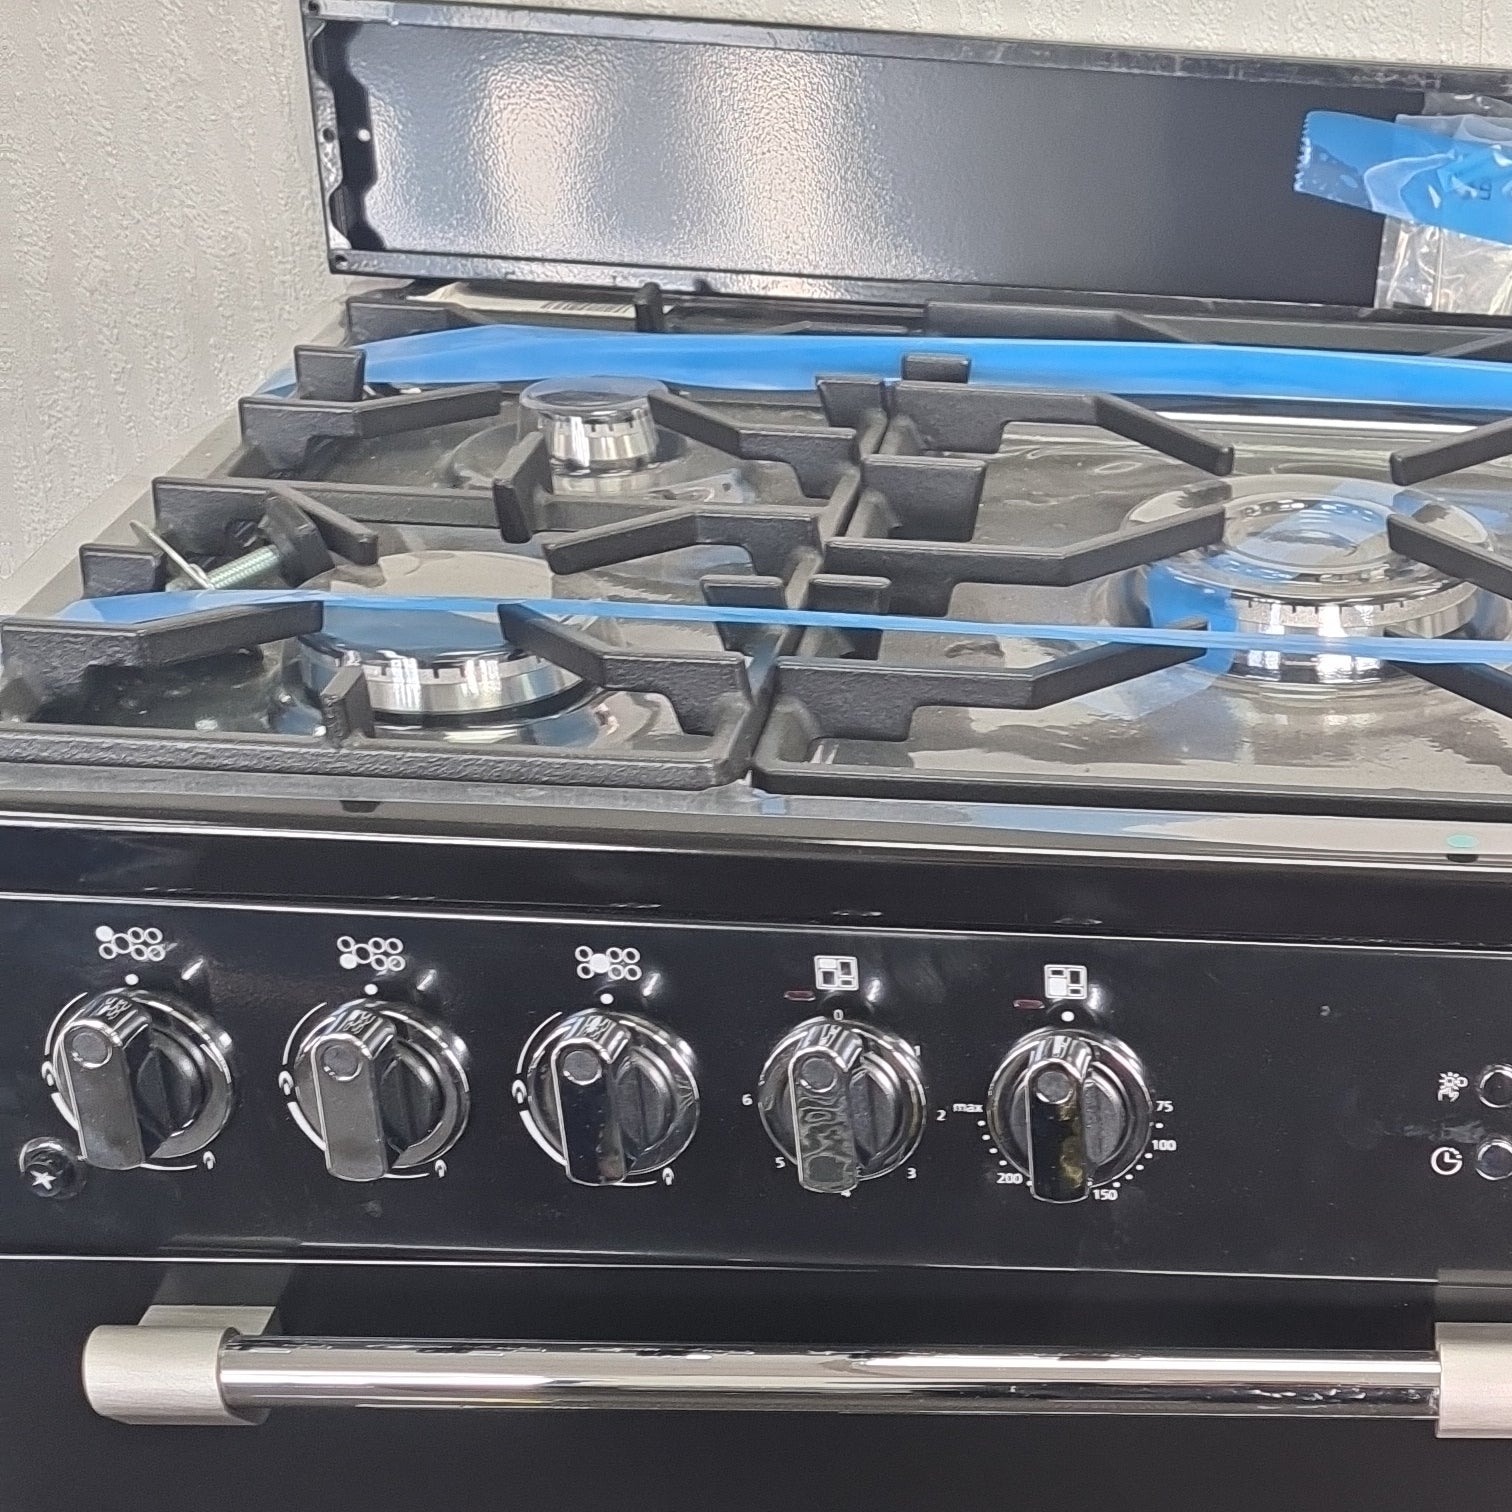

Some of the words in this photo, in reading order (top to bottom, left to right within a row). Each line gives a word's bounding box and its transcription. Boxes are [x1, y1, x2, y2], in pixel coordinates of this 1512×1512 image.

[741, 1093, 753, 1106] 6
[952, 1103, 984, 1114] max
[1155, 1101, 1174, 1113] 75
[936, 1109, 947, 1121] 2
[1151, 1139, 1177, 1151] 100
[775, 1157, 786, 1169] 5
[907, 1168, 918, 1180] 3
[996, 1172, 1023, 1184] 200
[1093, 1189, 1118, 1201] 150
